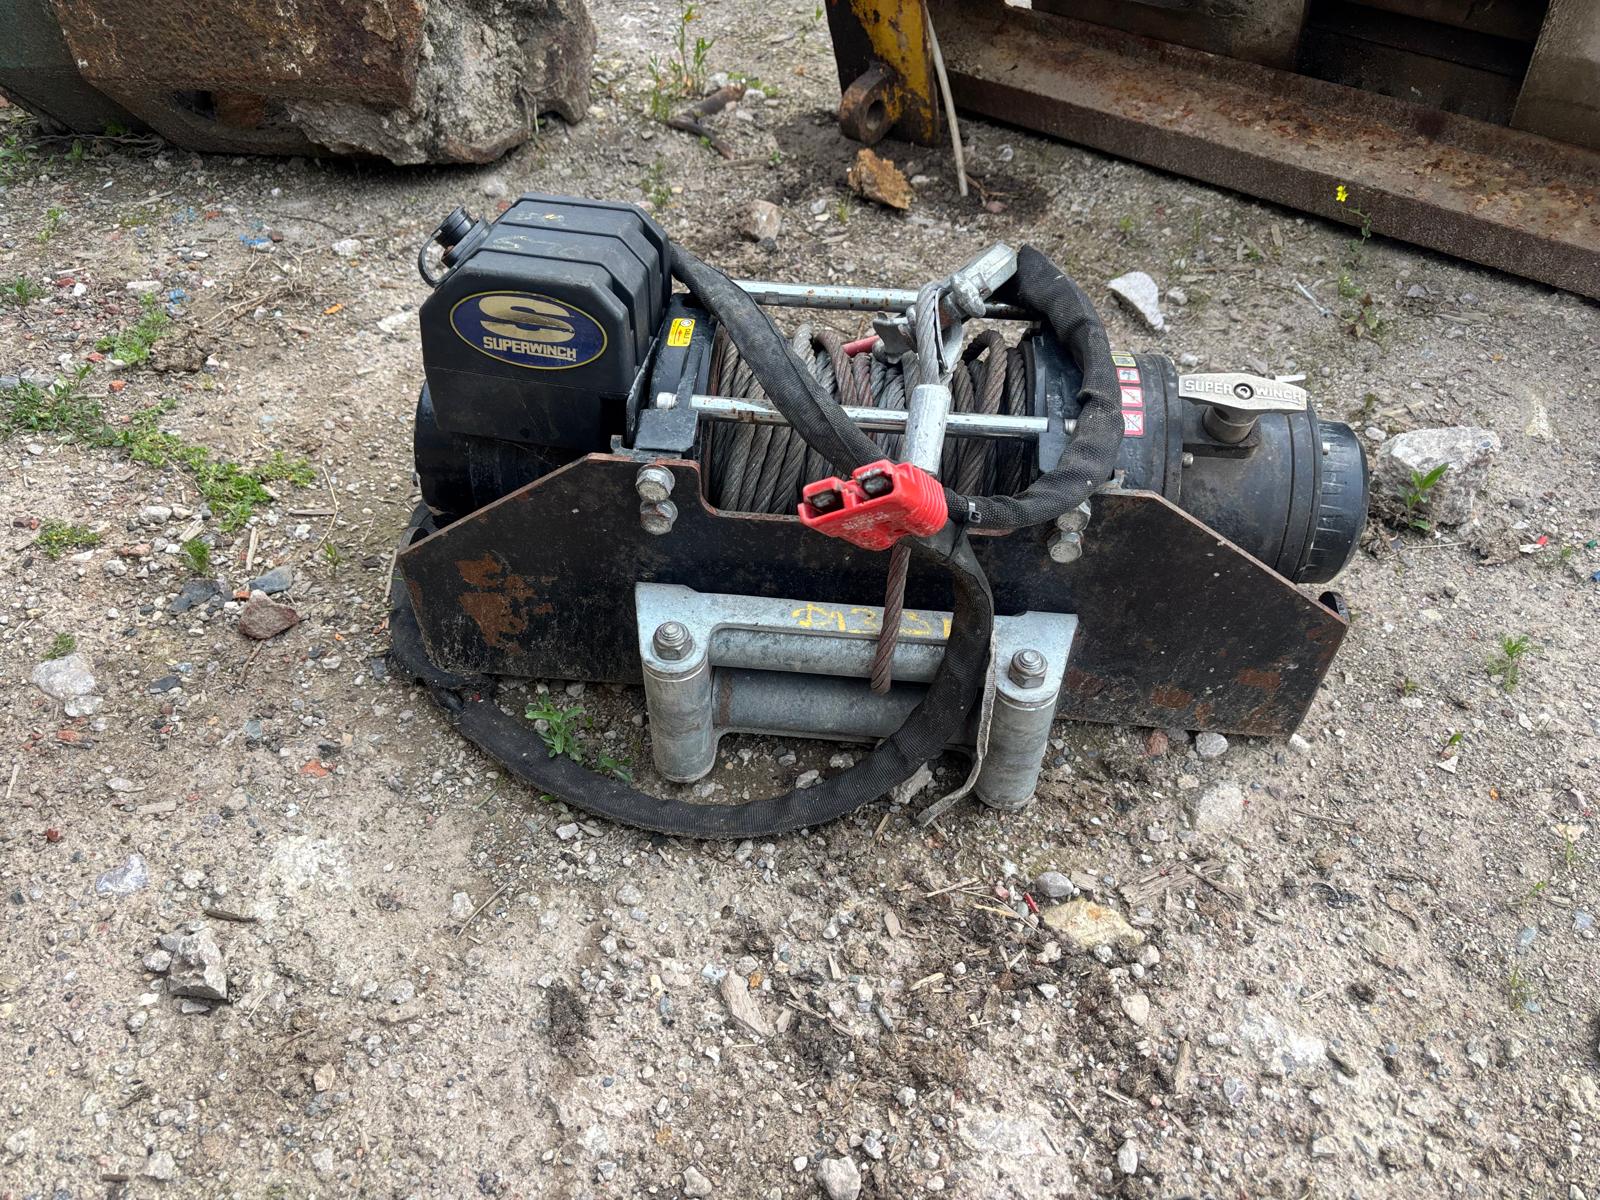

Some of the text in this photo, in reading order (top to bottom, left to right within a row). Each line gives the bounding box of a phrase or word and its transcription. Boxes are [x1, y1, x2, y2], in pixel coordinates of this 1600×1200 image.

[483, 337, 577, 361] SUPERWINCH
[1185, 379, 1302, 402] SUPER WINCH
